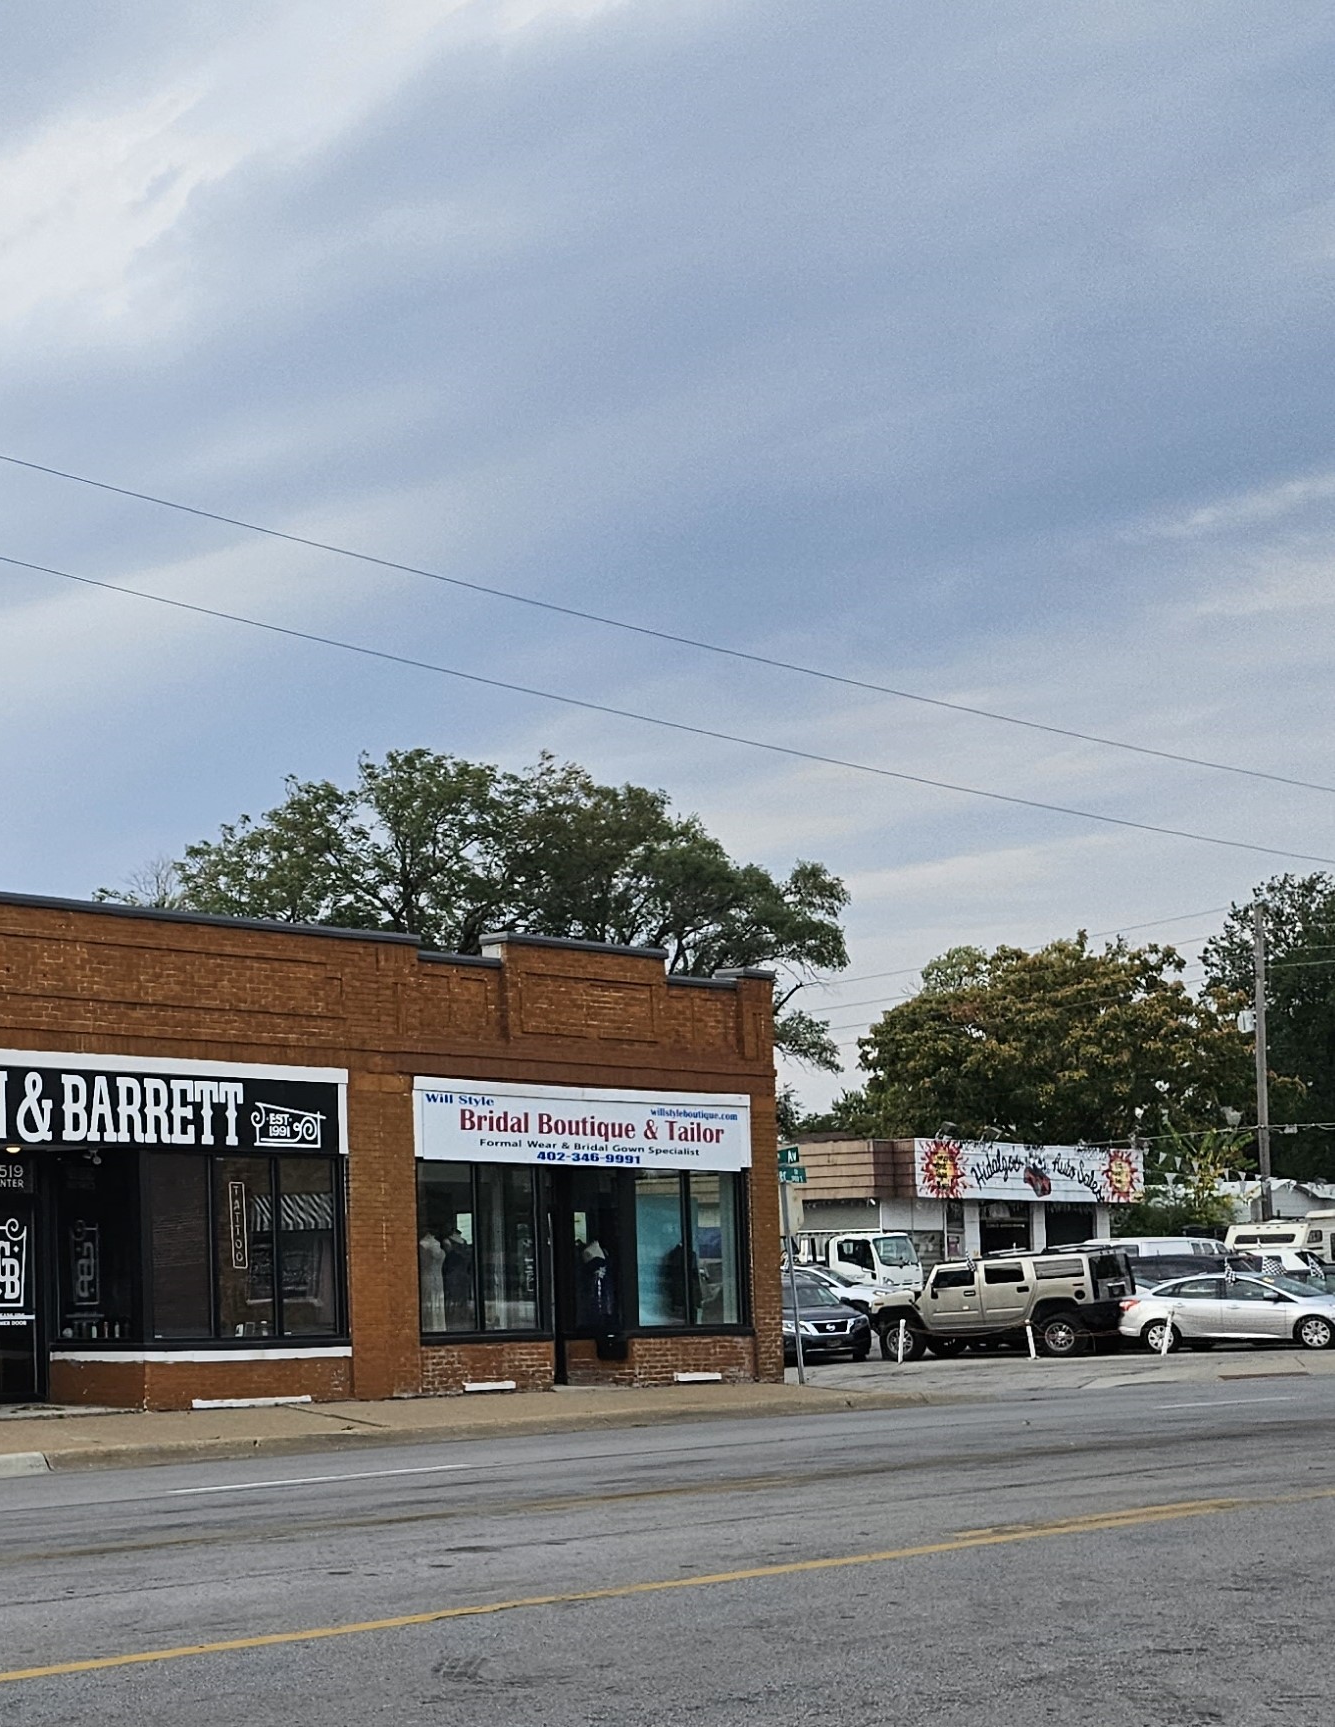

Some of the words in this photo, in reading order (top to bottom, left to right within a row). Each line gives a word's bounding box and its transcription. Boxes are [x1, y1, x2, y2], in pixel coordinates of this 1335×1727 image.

[17, 1071, 53, 1143] &
[61, 1073, 244, 1146] BARRETT
[425, 1093, 453, 1104] Will
[458, 1095, 495, 1107] Style
[650, 1107, 738, 1121] willstyleboutique.com
[269, 1125, 291, 1138] 1991
[460, 1108, 529, 1134] Bridal
[538, 1113, 636, 1142] Boutique
[643, 1119, 658, 1140] &
[666, 1120, 724, 1144] Tailor
[479, 1138, 522, 1148] Formal
[527, 1140, 557, 1149] Wear
[574, 1142, 608, 1152] Bridal
[612, 1144, 645, 1153] Gown
[648, 1145, 700, 1156] Specialist
[537, 1151, 641, 1164] 402-346-9991
[1052, 1153, 1076, 1180] Auto
[232, 1185, 244, 1262] TATTOO
